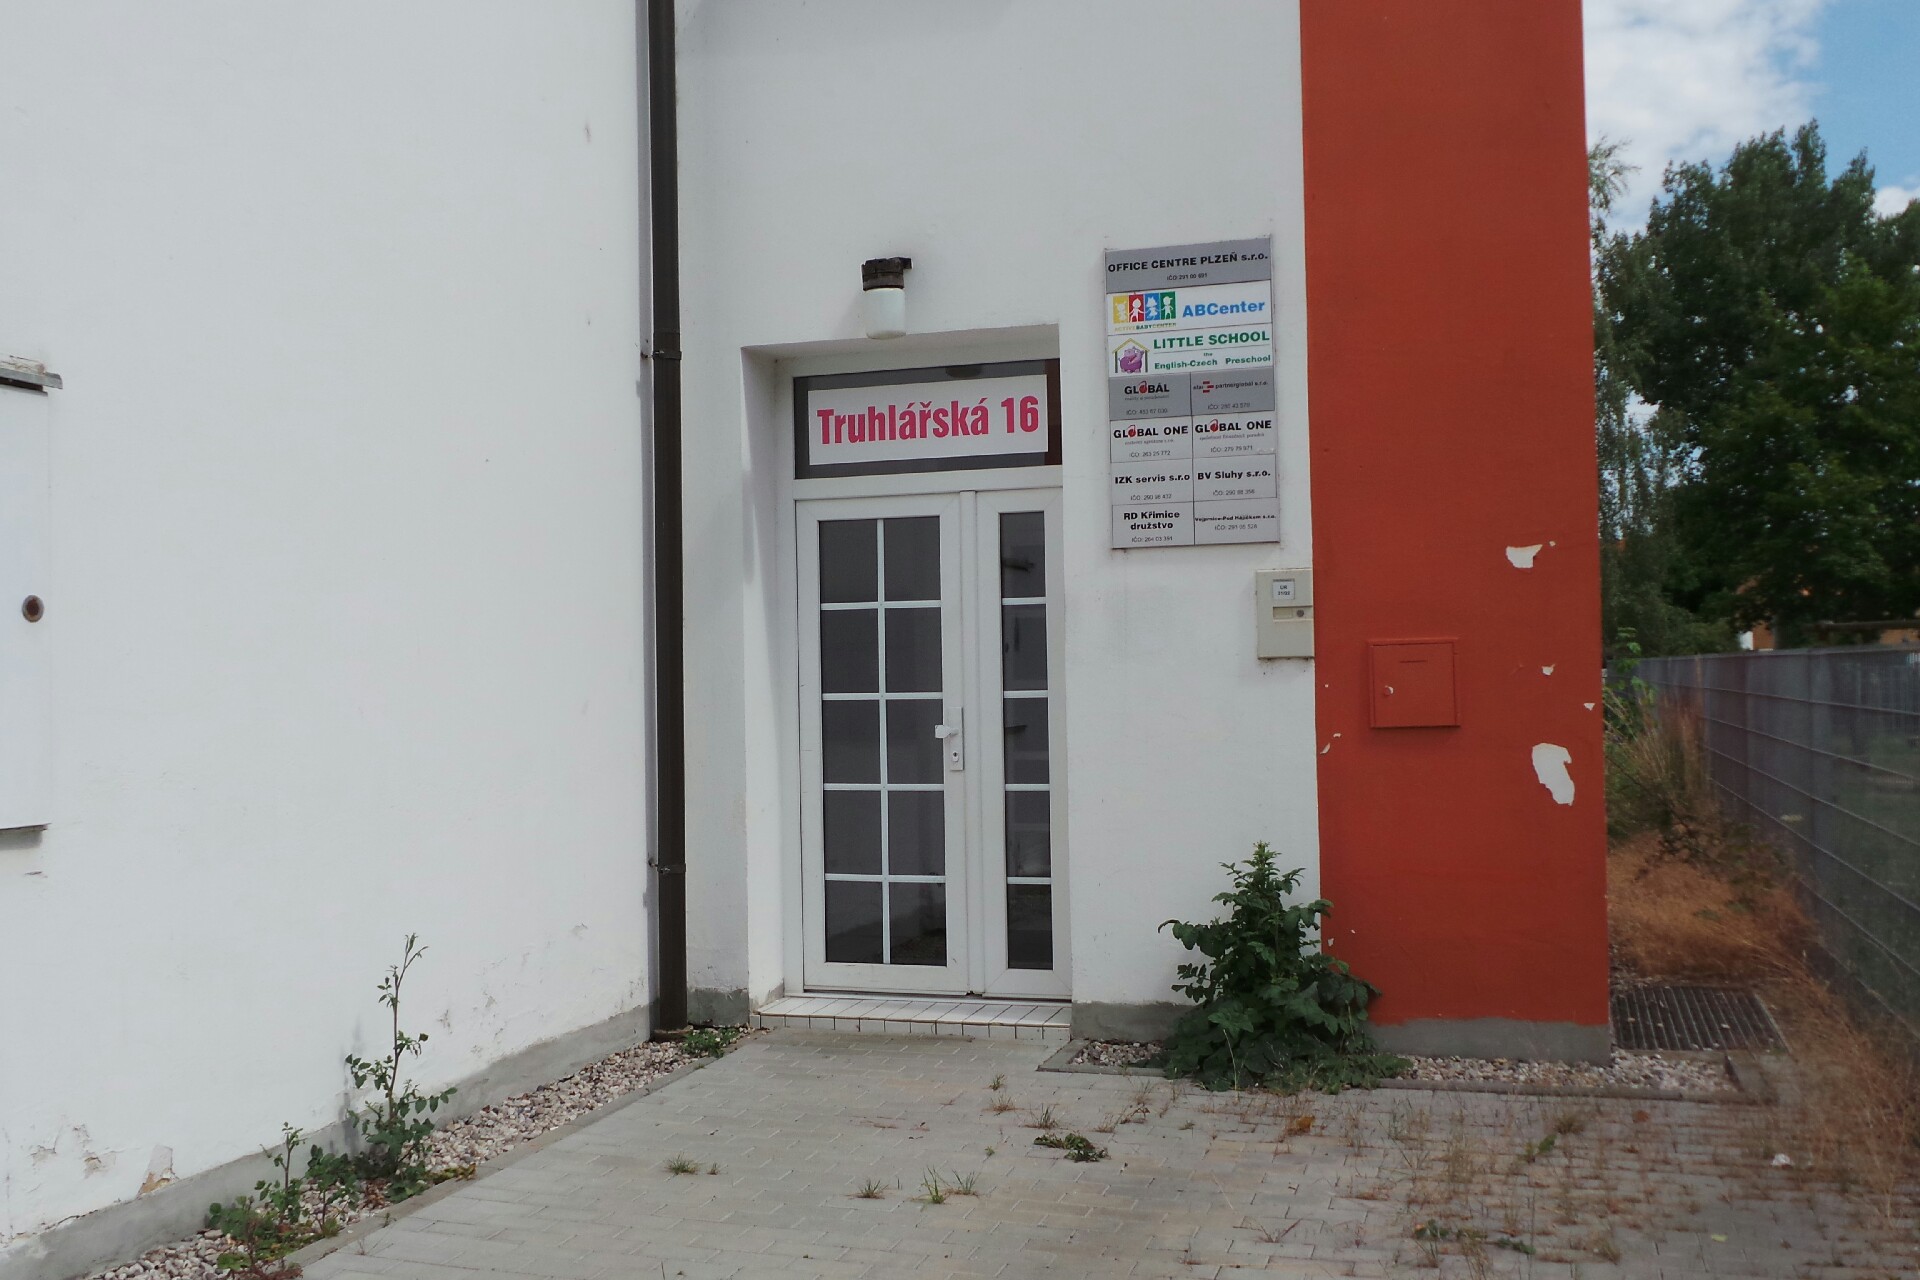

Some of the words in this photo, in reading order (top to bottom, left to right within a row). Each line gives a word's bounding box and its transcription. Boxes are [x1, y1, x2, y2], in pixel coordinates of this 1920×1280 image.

[1108, 261, 1148, 273] OFFICE
[1151, 257, 1197, 269] CENTRE
[1200, 252, 1238, 265] PLZEŇ
[1241, 252, 1268, 262] s.r.o.
[1182, 301, 1265, 318] ABCenter
[1153, 335, 1204, 349] LITTLE
[1208, 331, 1270, 345] SCHOOL
[1154, 359, 1218, 371] English-Czech
[1225, 354, 1271, 365] Preschool
[817, 398, 989, 445] Truhlářská
[1001, 395, 1039, 434] 16
[1195, 419, 1241, 433] GLOBAL
[1246, 420, 1272, 430] ONE
[1113, 425, 1159, 438] GLOBAL
[1163, 426, 1189, 435] ONE
[1115, 476, 1133, 484] IZK
[1136, 474, 1166, 483] servis
[1197, 472, 1212, 480] BV
[1215, 470, 1243, 480] Sluhy
[1246, 470, 1271, 478] s.r.o.
[1123, 512, 1138, 520] RD
[1141, 510, 1180, 519] Křimice
[1130, 522, 1174, 530] družstvo
